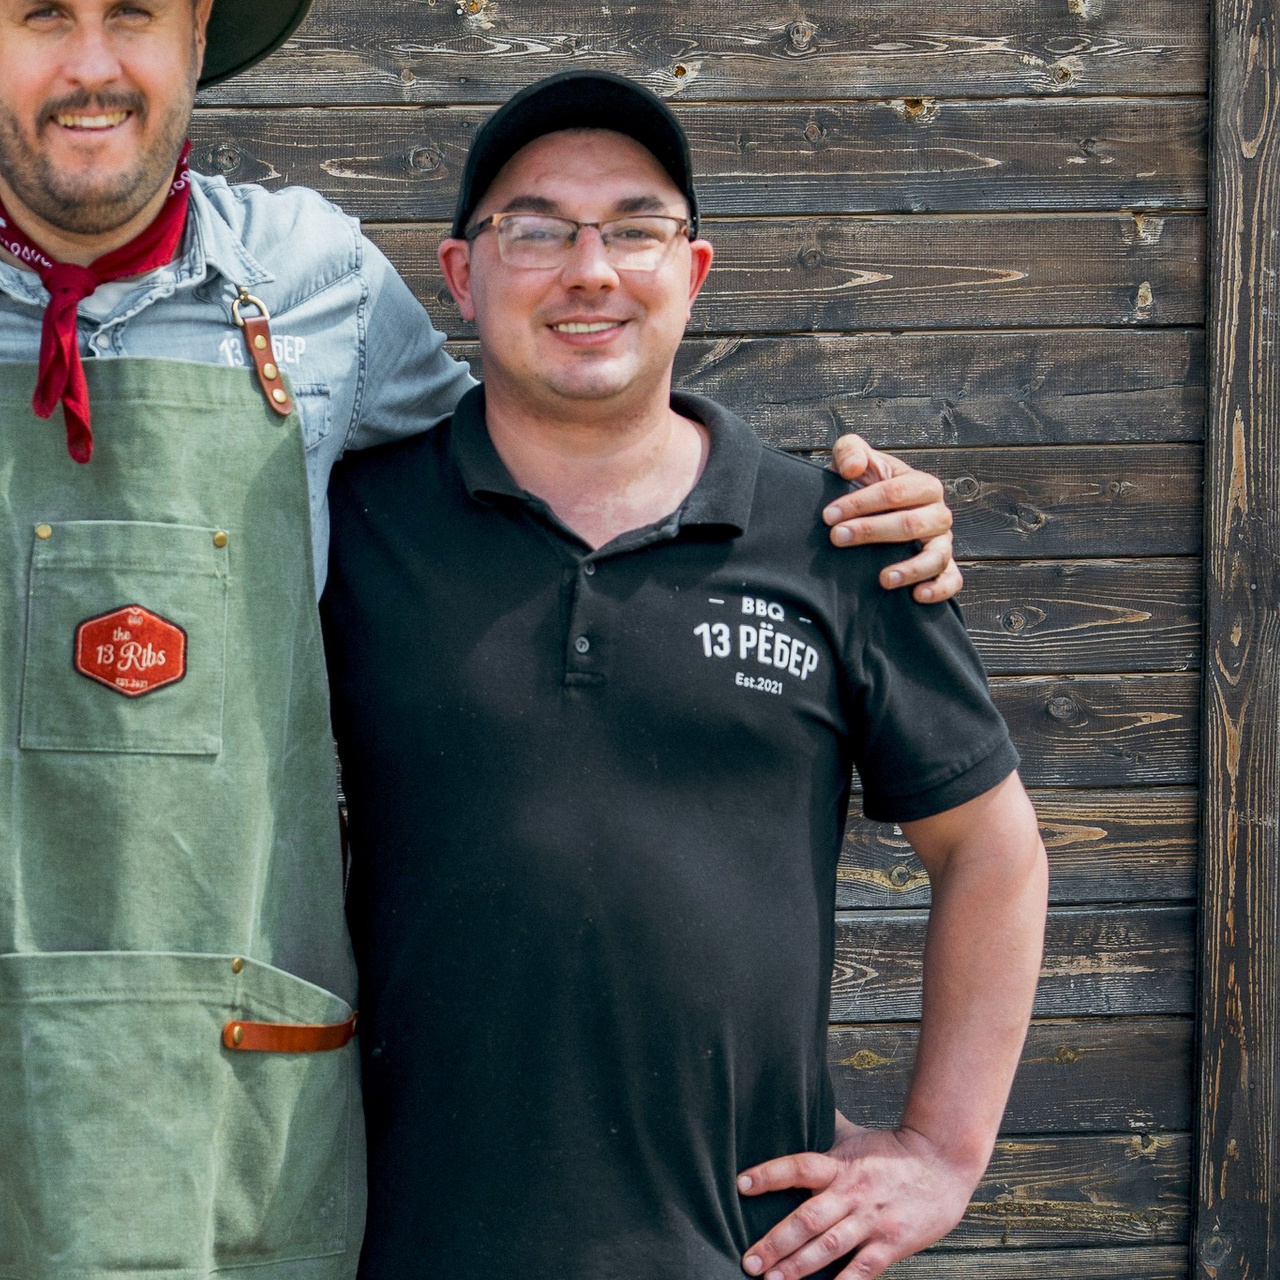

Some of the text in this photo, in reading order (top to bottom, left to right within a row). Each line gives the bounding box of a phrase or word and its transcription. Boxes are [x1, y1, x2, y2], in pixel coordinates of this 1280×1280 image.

[219, 334, 306, 367] 13 БЕР
[741, 596, 784, 622] BBQ
[112, 626, 131, 642] the
[96, 641, 167, 672] 13 Ribs
[693, 622, 820, 681] 13 РЁБЕР
